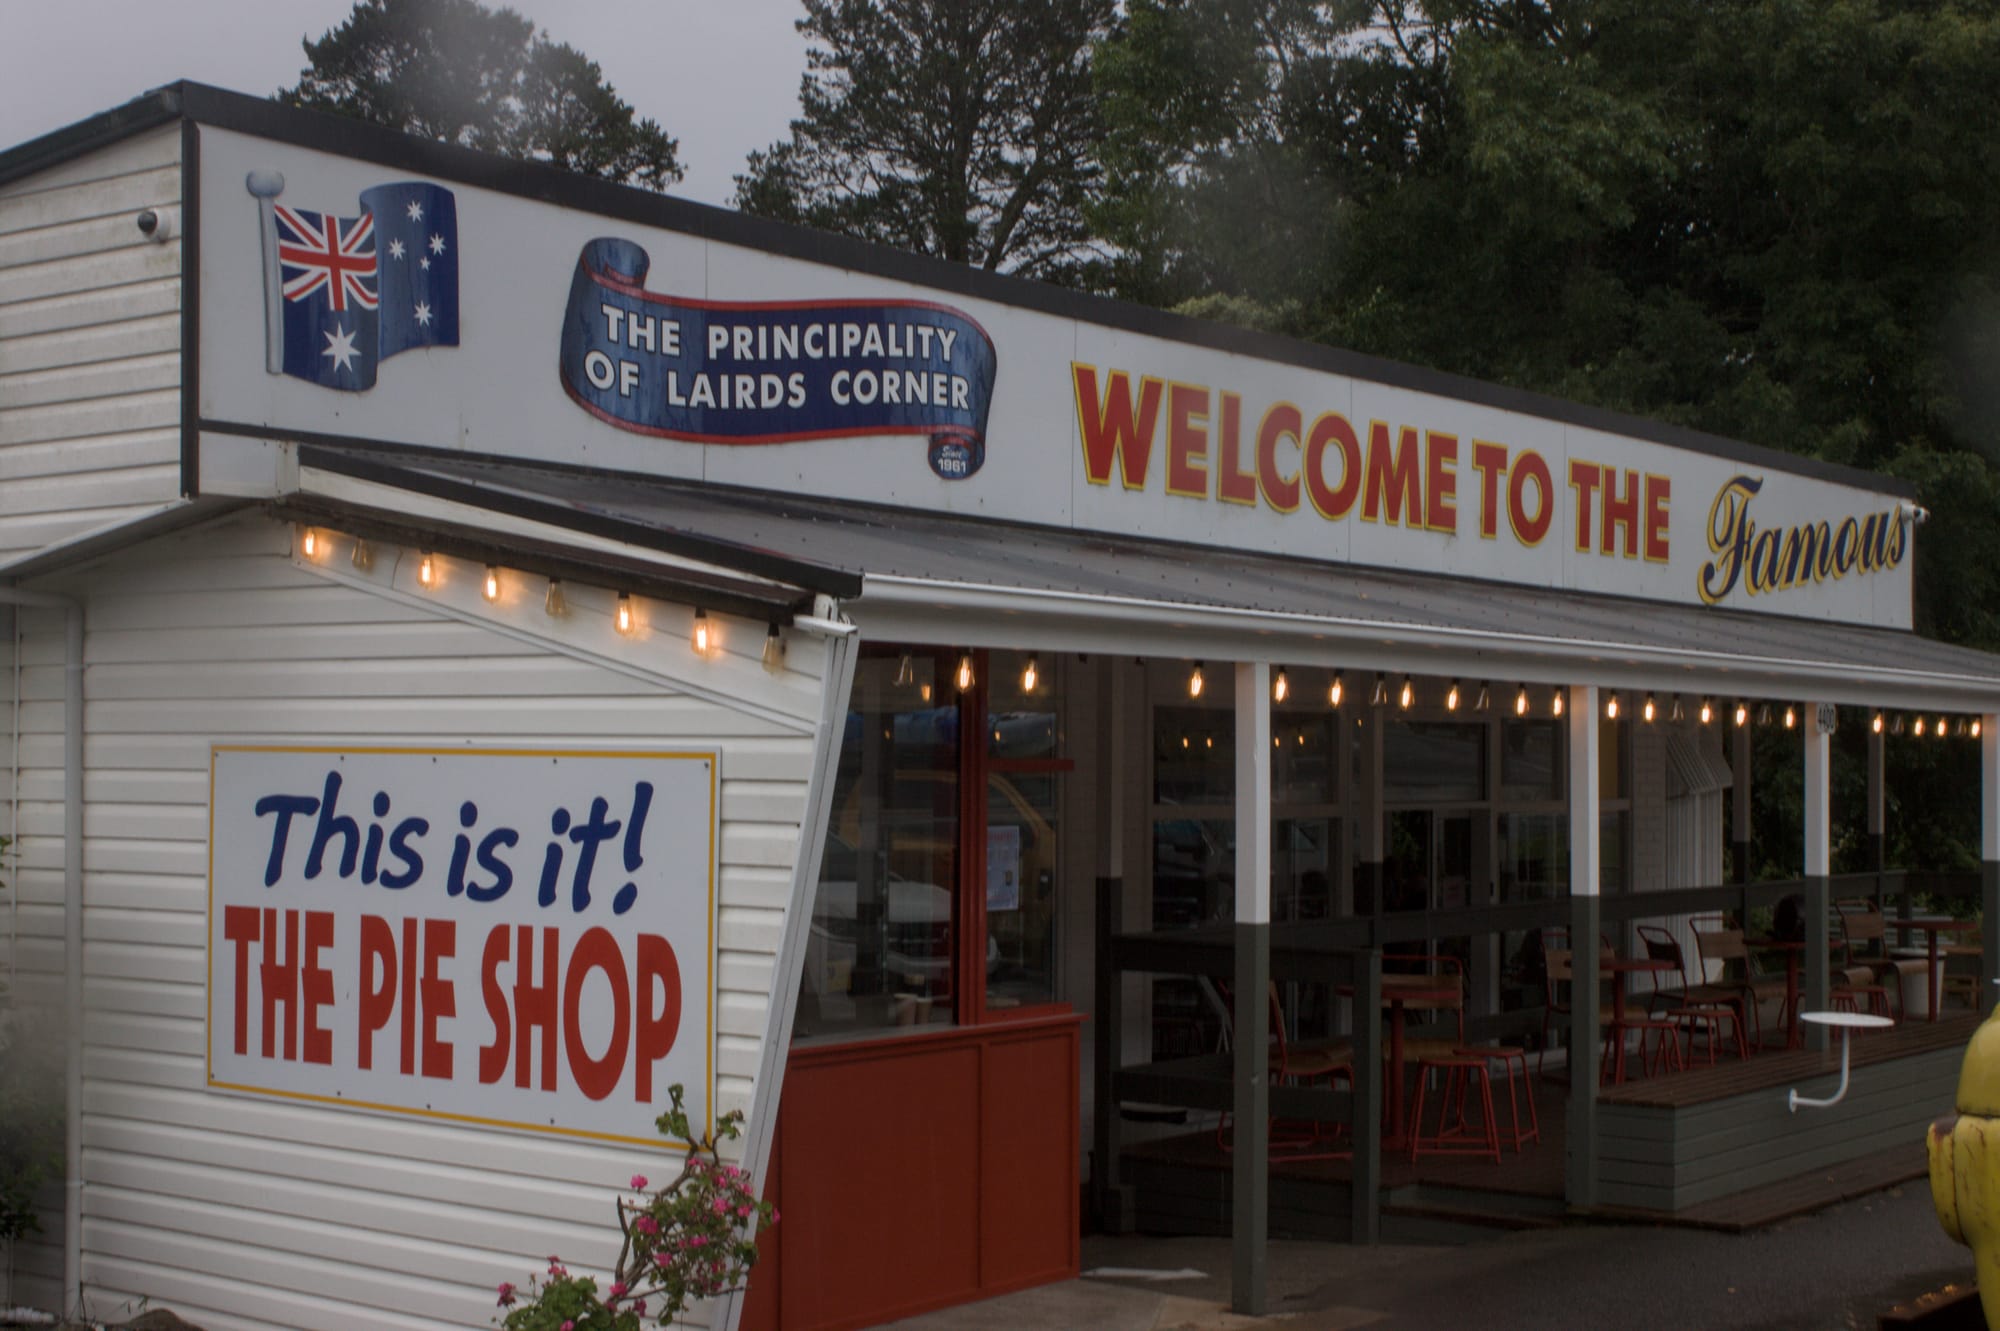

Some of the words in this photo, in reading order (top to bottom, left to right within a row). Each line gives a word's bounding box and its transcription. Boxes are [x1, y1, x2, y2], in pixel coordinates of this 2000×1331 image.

[584, 349, 640, 396] OF
[667, 370, 806, 410] LAIRDS
[830, 369, 969, 410] CORNER
[602, 303, 681, 357] THE
[707, 322, 957, 362] PRINCIPALITY
[938, 458, 967, 473] 1961
[1071, 360, 1459, 533] WELCOME
[1472, 439, 1554, 547] TO
[1568, 458, 1671, 563] THE
[1697, 474, 1906, 604] Famous
[255, 770, 430, 889] This
[447, 801, 519, 902] is
[538, 781, 654, 915] it!
[224, 905, 335, 1066] THE
[358, 914, 457, 1081] PIE
[479, 923, 682, 1104] SHOP
